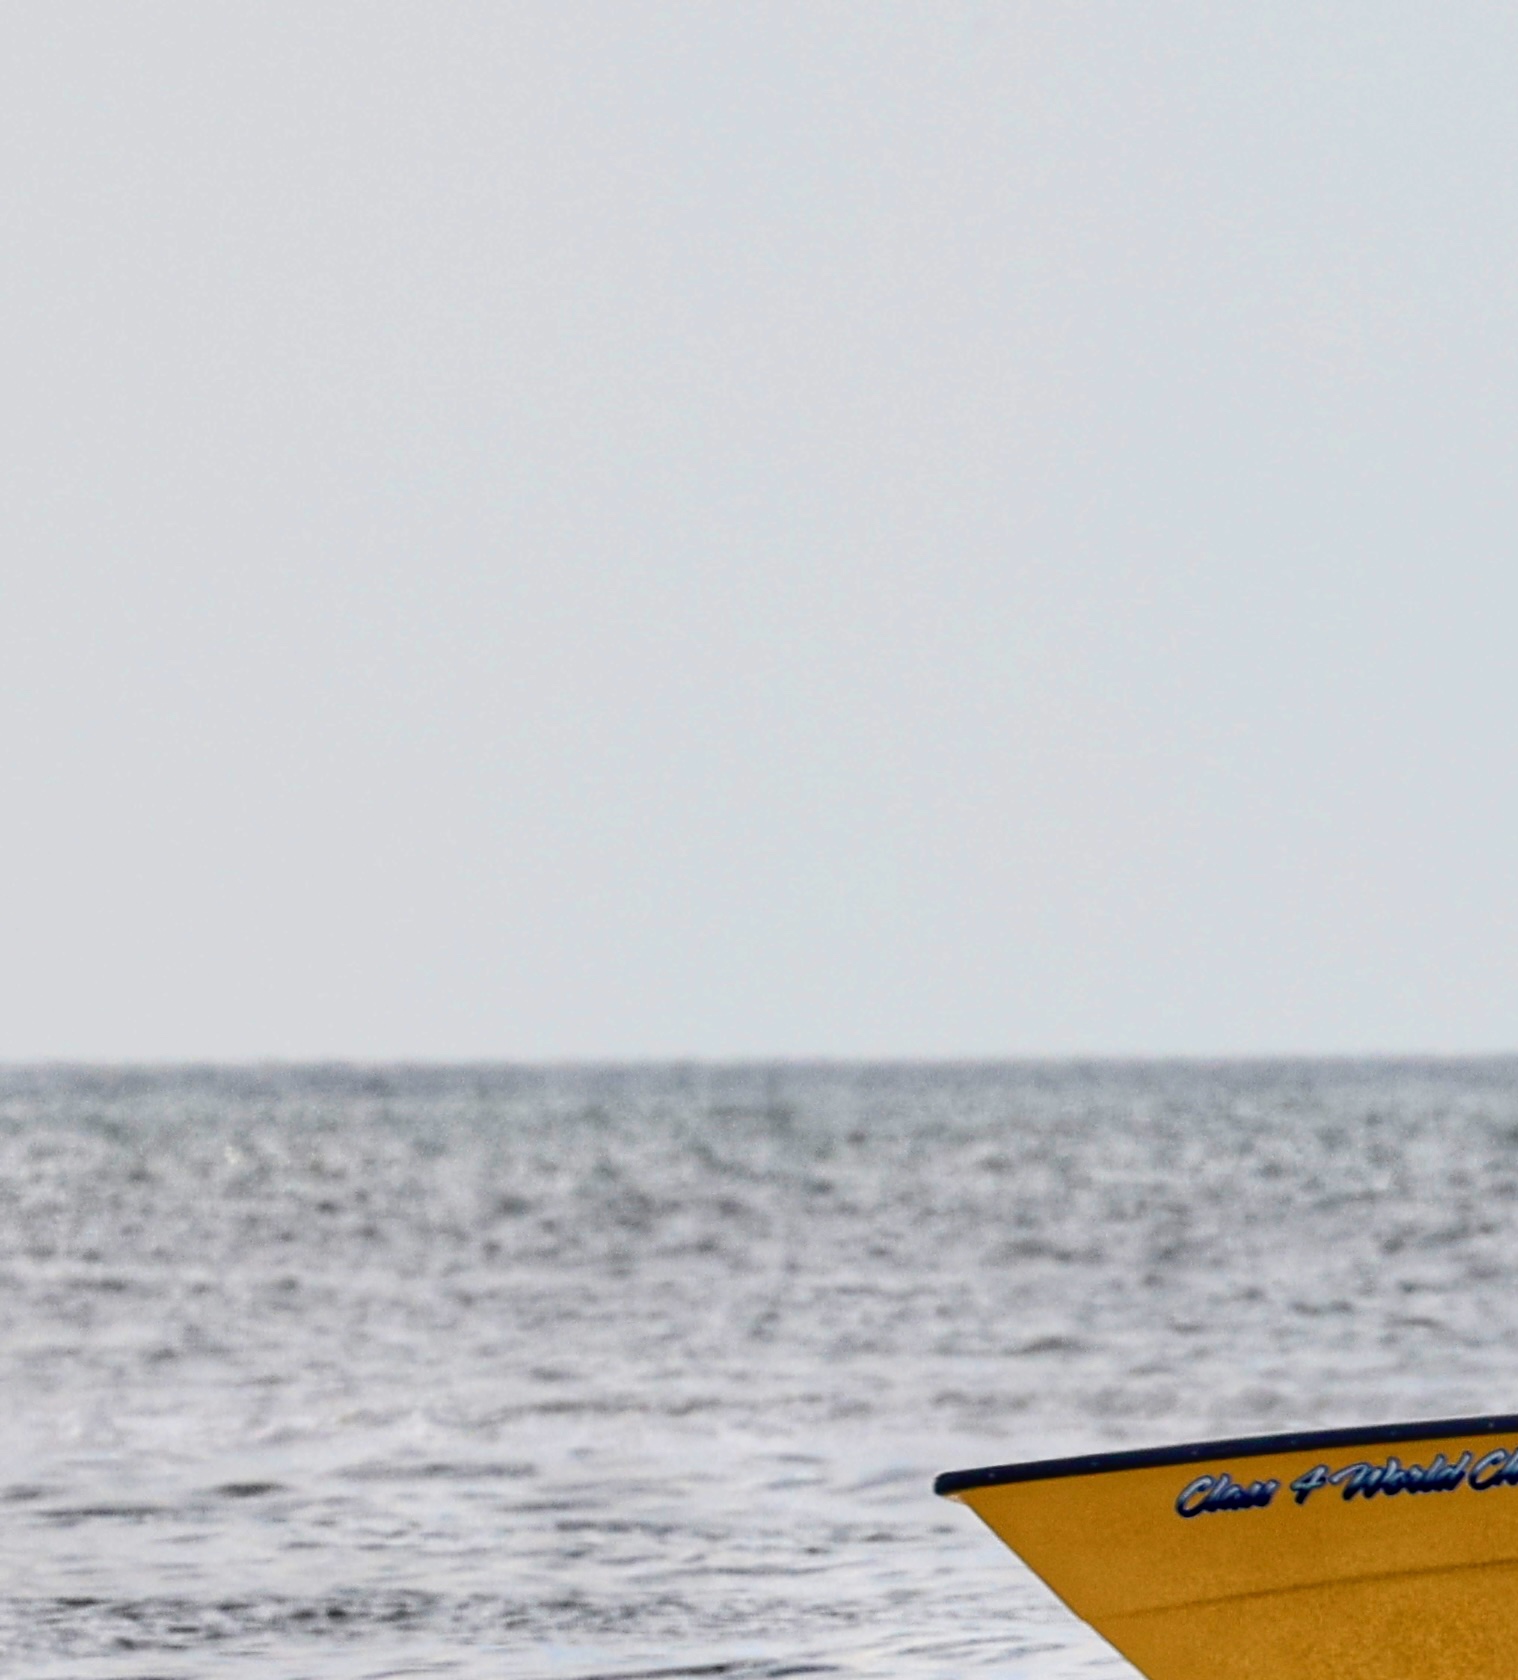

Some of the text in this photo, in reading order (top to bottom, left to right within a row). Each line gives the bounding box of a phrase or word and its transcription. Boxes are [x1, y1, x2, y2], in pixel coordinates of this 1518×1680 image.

[1176, 1472, 1280, 1518] Class
[1290, 1464, 1330, 1505] 4
[1331, 1450, 1471, 1501] World
